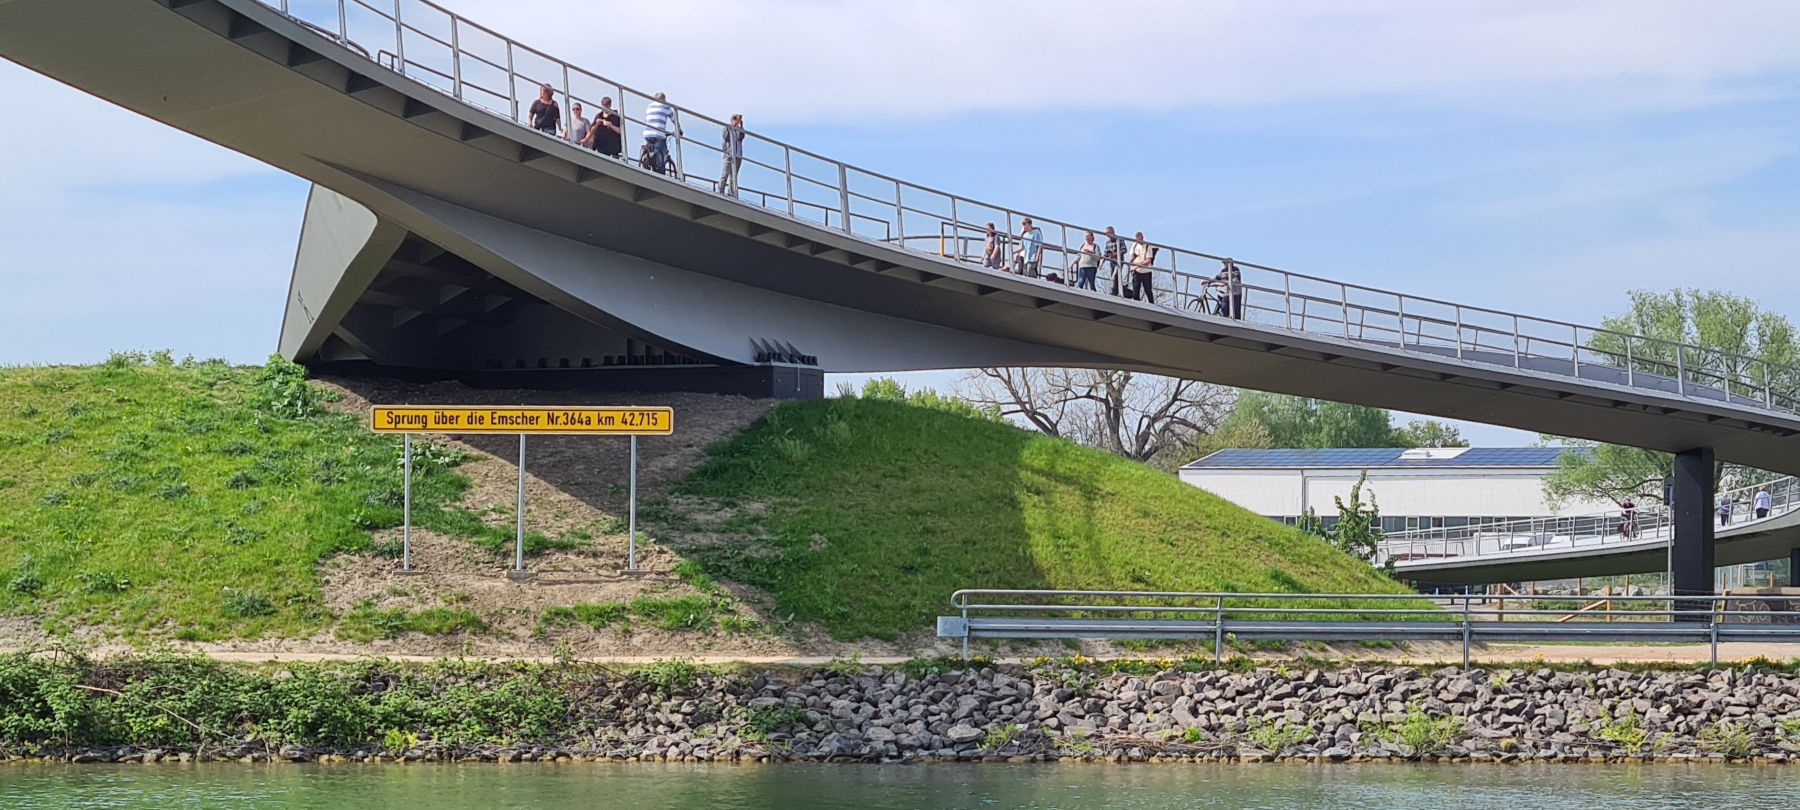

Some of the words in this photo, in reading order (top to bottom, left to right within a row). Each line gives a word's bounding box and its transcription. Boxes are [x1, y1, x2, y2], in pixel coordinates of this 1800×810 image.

[386, 411, 428, 429] Sprung
[434, 411, 460, 425] über
[467, 411, 485, 425] die
[490, 411, 541, 426] Emscher
[547, 411, 592, 426] Nr.364a
[598, 412, 615, 426] km
[621, 413, 658, 428] 42,715
